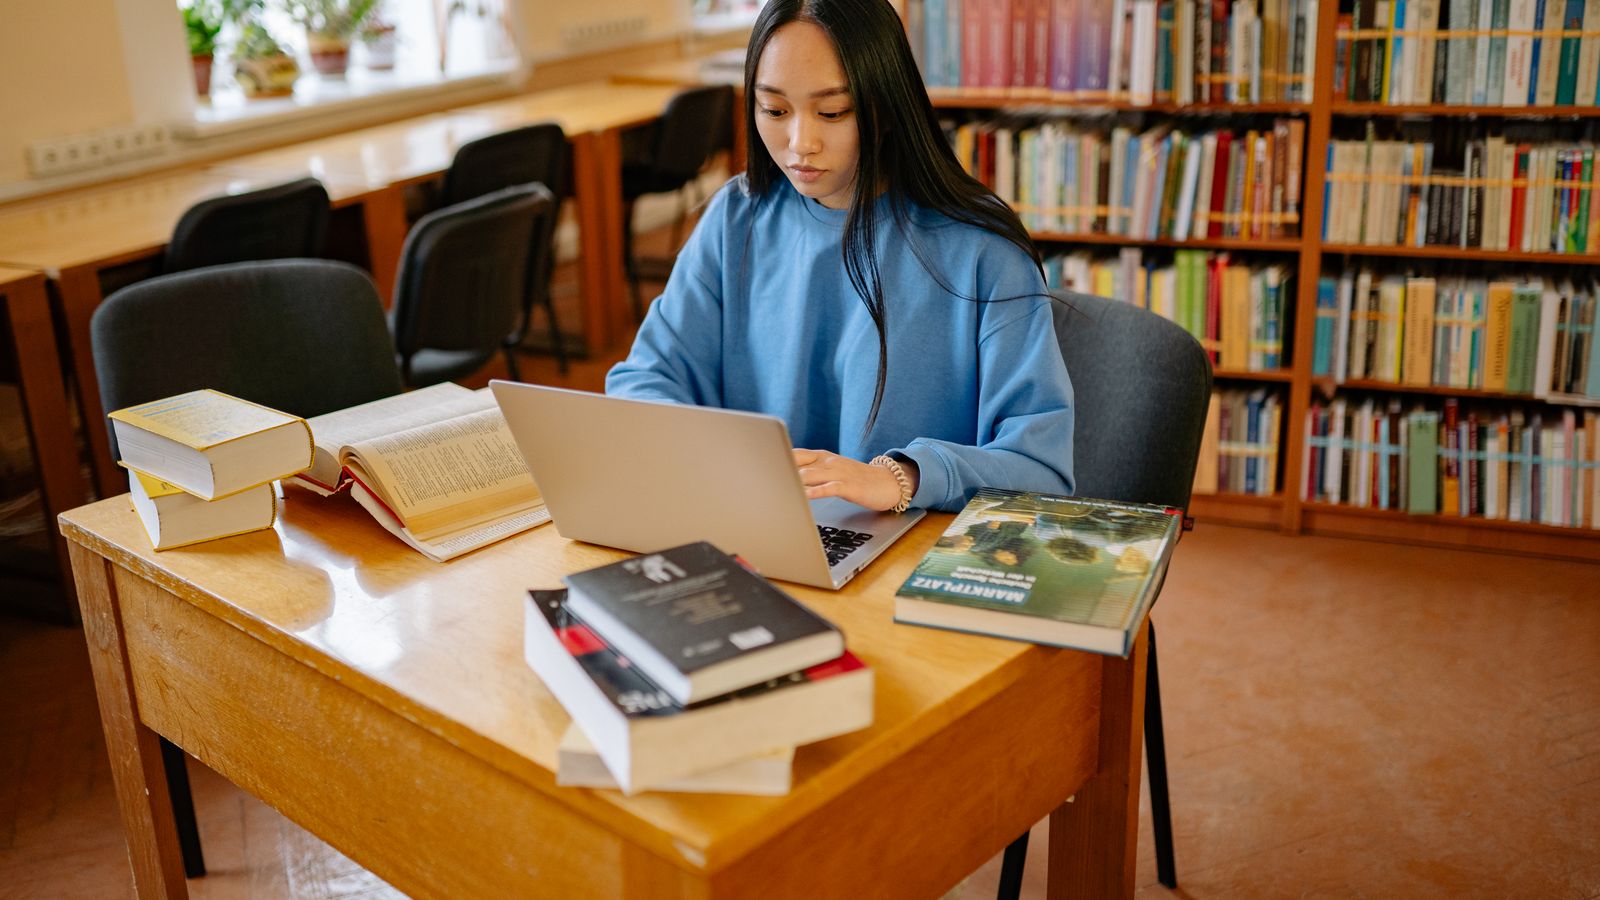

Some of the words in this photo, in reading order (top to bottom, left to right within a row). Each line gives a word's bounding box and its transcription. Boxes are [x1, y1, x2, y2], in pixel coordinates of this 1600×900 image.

[1005, 572, 1024, 581] der
[912, 576, 1026, 603] MARKTPLATZ
[988, 577, 1033, 590] Deutsche
